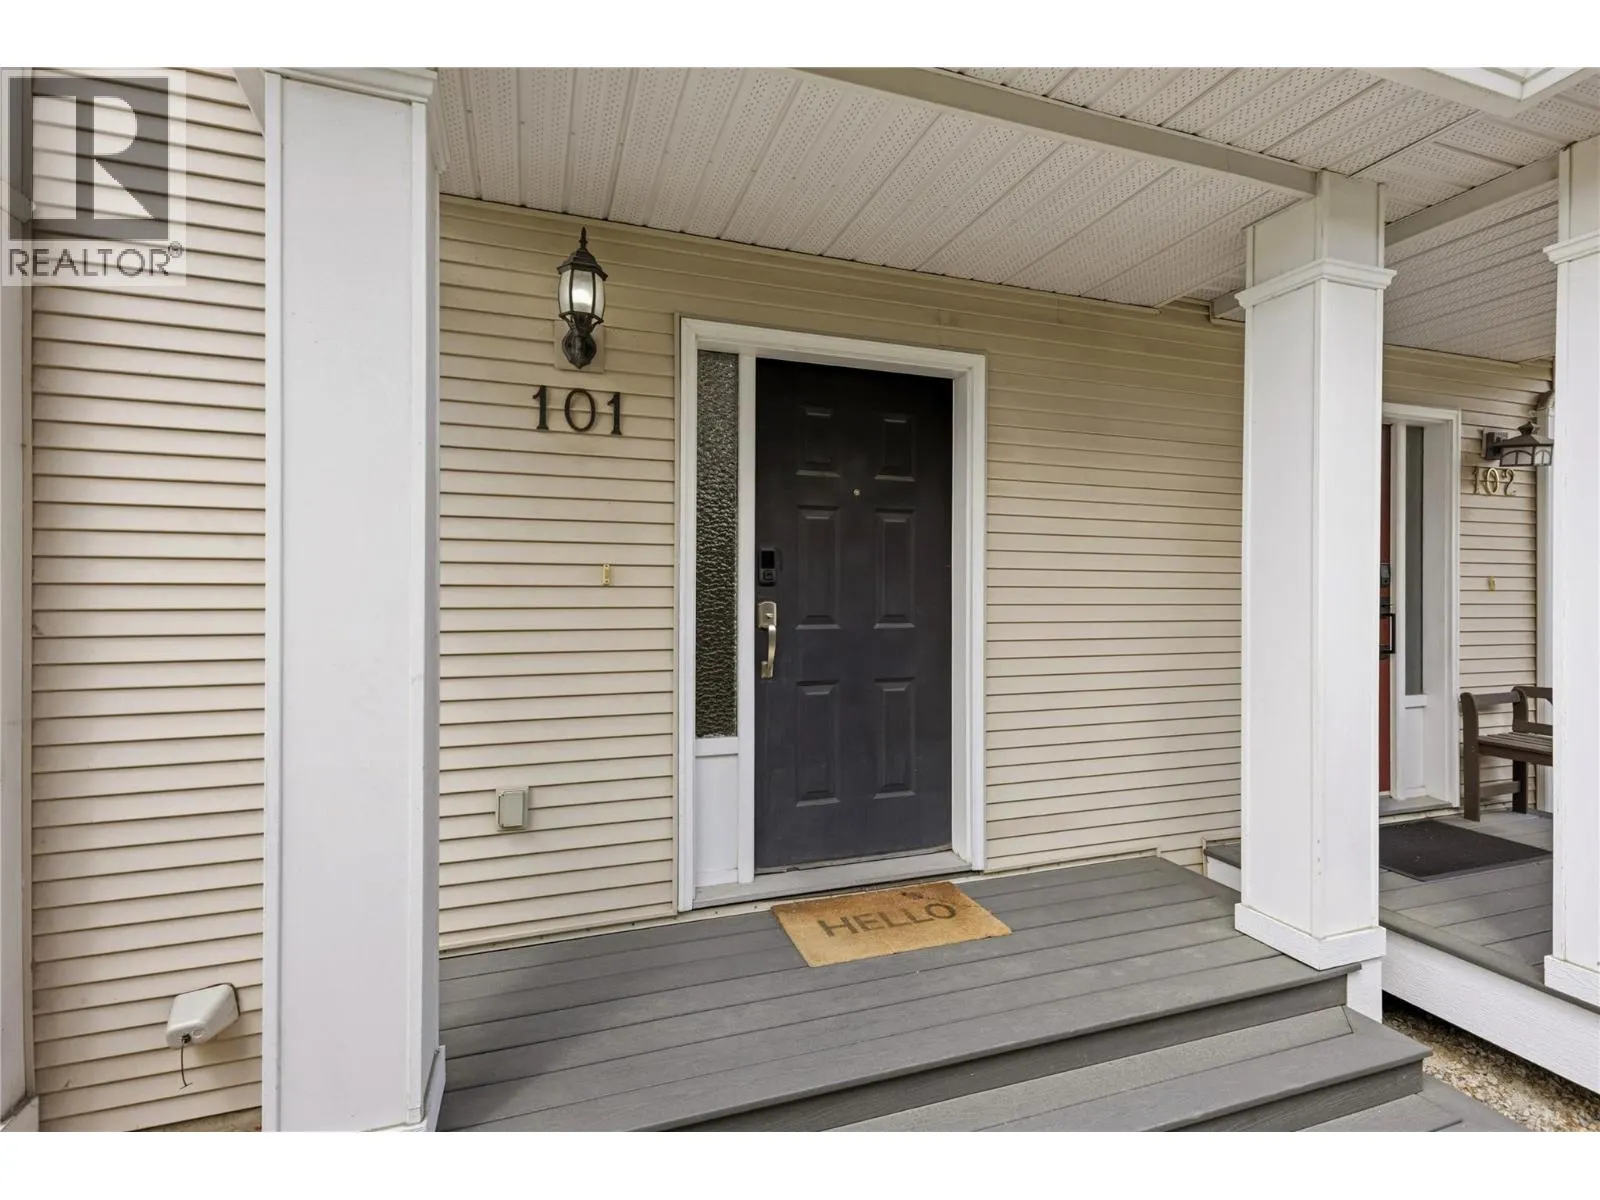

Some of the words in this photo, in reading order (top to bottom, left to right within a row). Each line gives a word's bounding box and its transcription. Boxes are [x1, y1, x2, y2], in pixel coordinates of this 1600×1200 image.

[532, 384, 622, 436] 101
[1472, 466, 1517, 497] 102
[817, 902, 957, 938] HELLO
